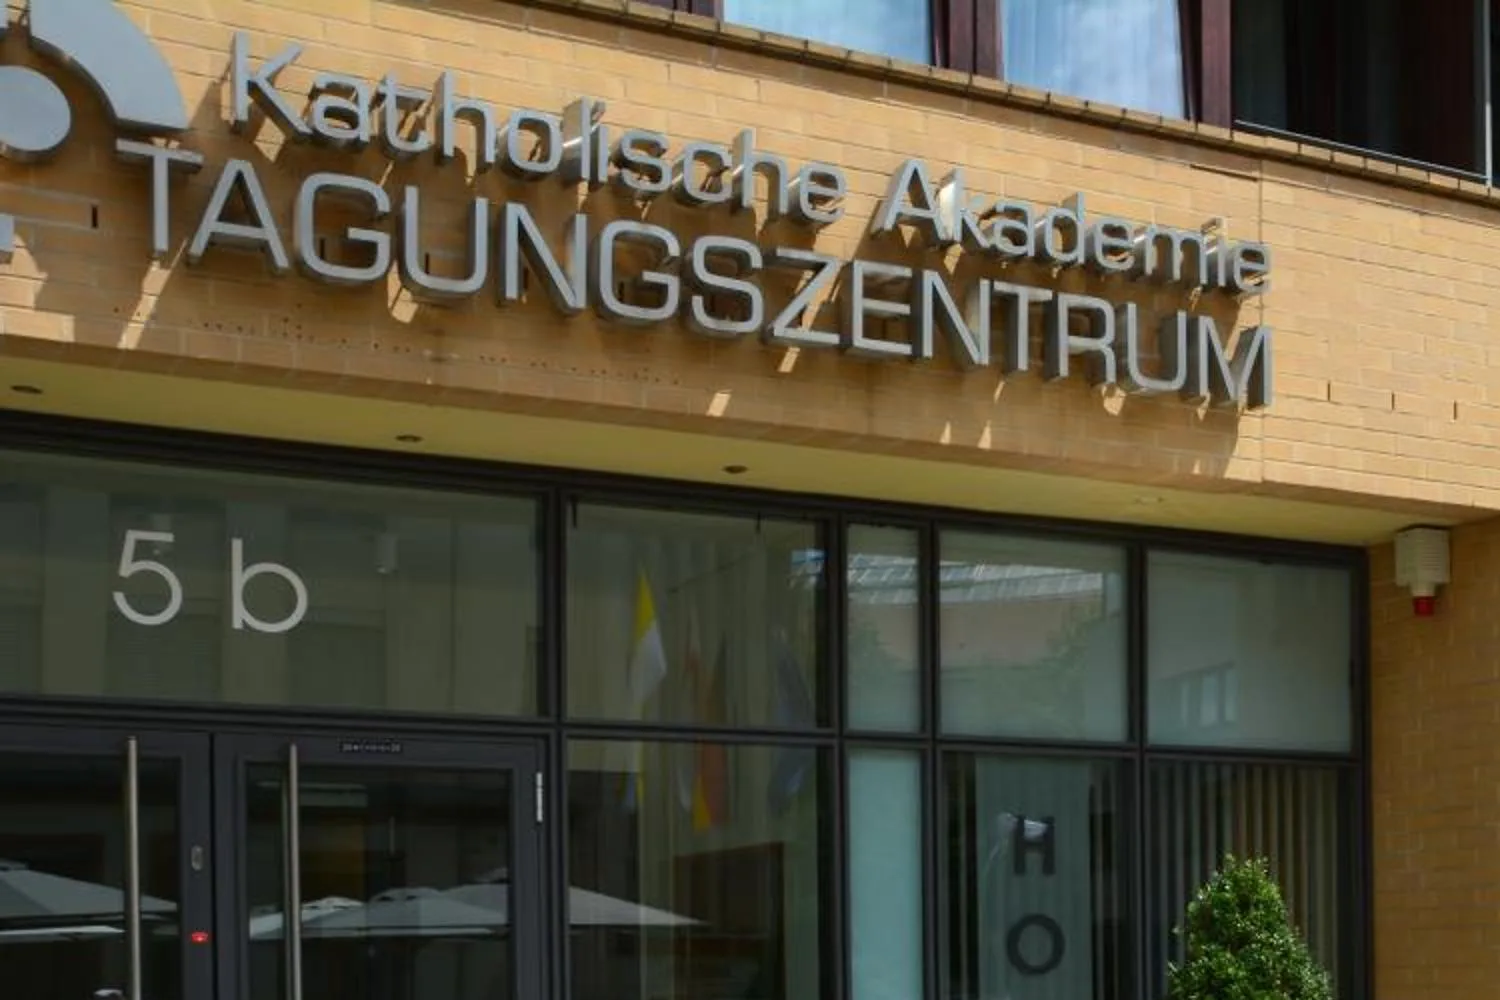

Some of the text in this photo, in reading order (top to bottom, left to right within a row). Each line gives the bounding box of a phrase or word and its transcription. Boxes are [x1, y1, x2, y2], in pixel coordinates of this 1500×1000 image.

[116, 138, 1273, 409] TAGUNGSZENTRUM
[230, 31, 1272, 295] Katholische Akademie
[112, 529, 309, 634] 5 b
